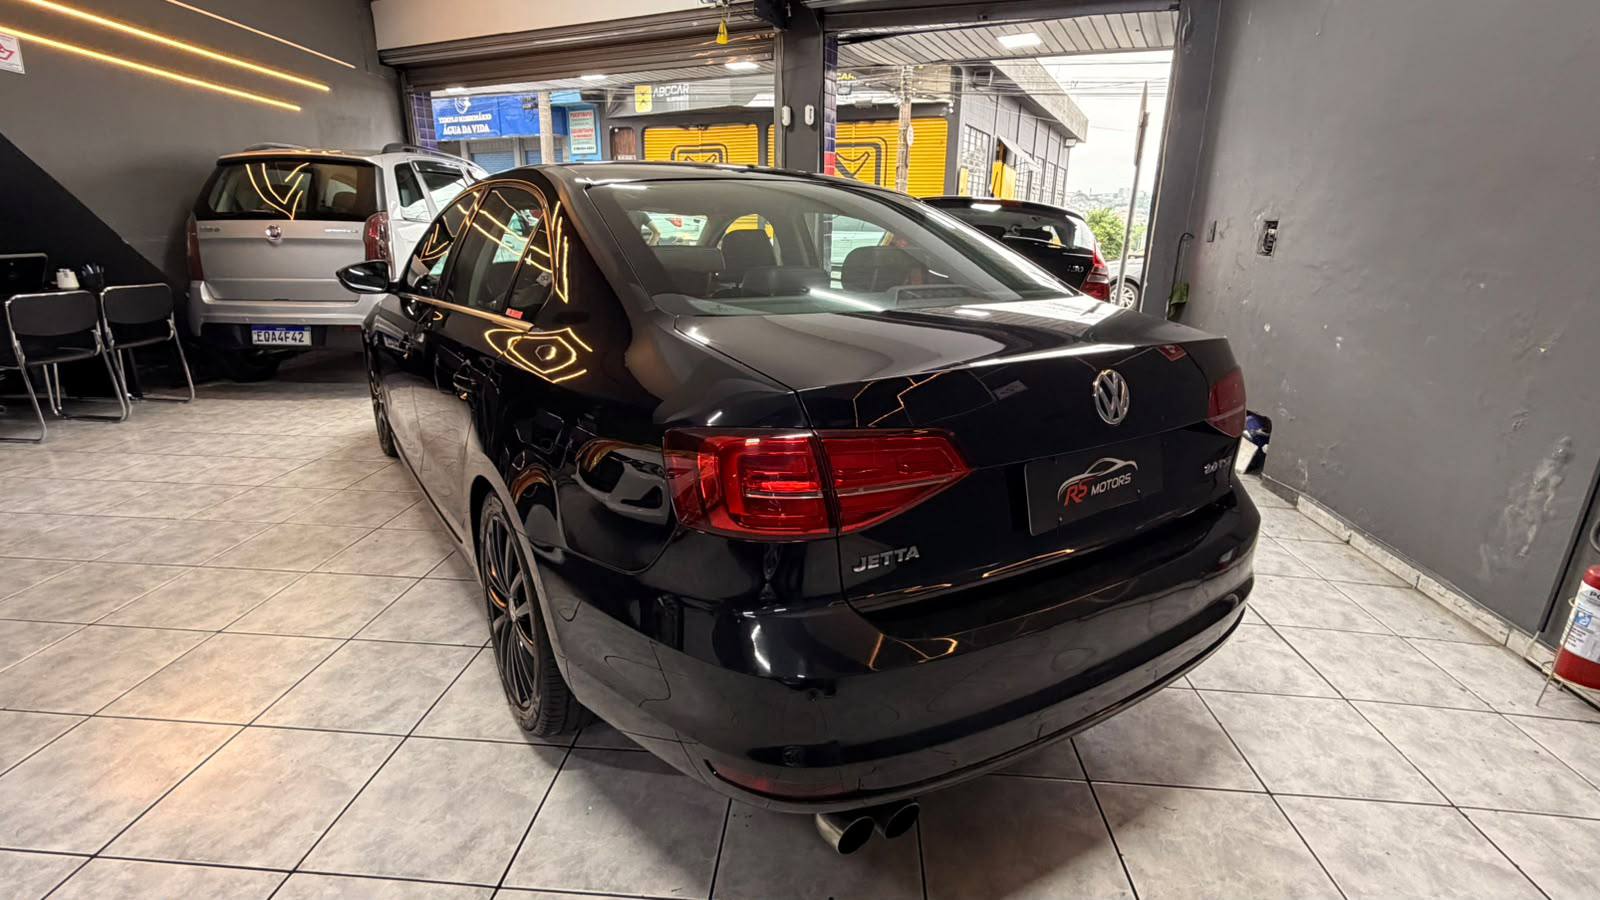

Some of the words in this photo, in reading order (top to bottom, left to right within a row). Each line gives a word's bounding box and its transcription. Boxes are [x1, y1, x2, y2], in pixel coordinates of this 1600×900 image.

[442, 124, 461, 135] ÁGUA
[461, 125, 472, 134] DA
[472, 123, 490, 133] VIDA
[1090, 472, 1132, 497] MOTORS
[853, 545, 920, 572] JETTA
